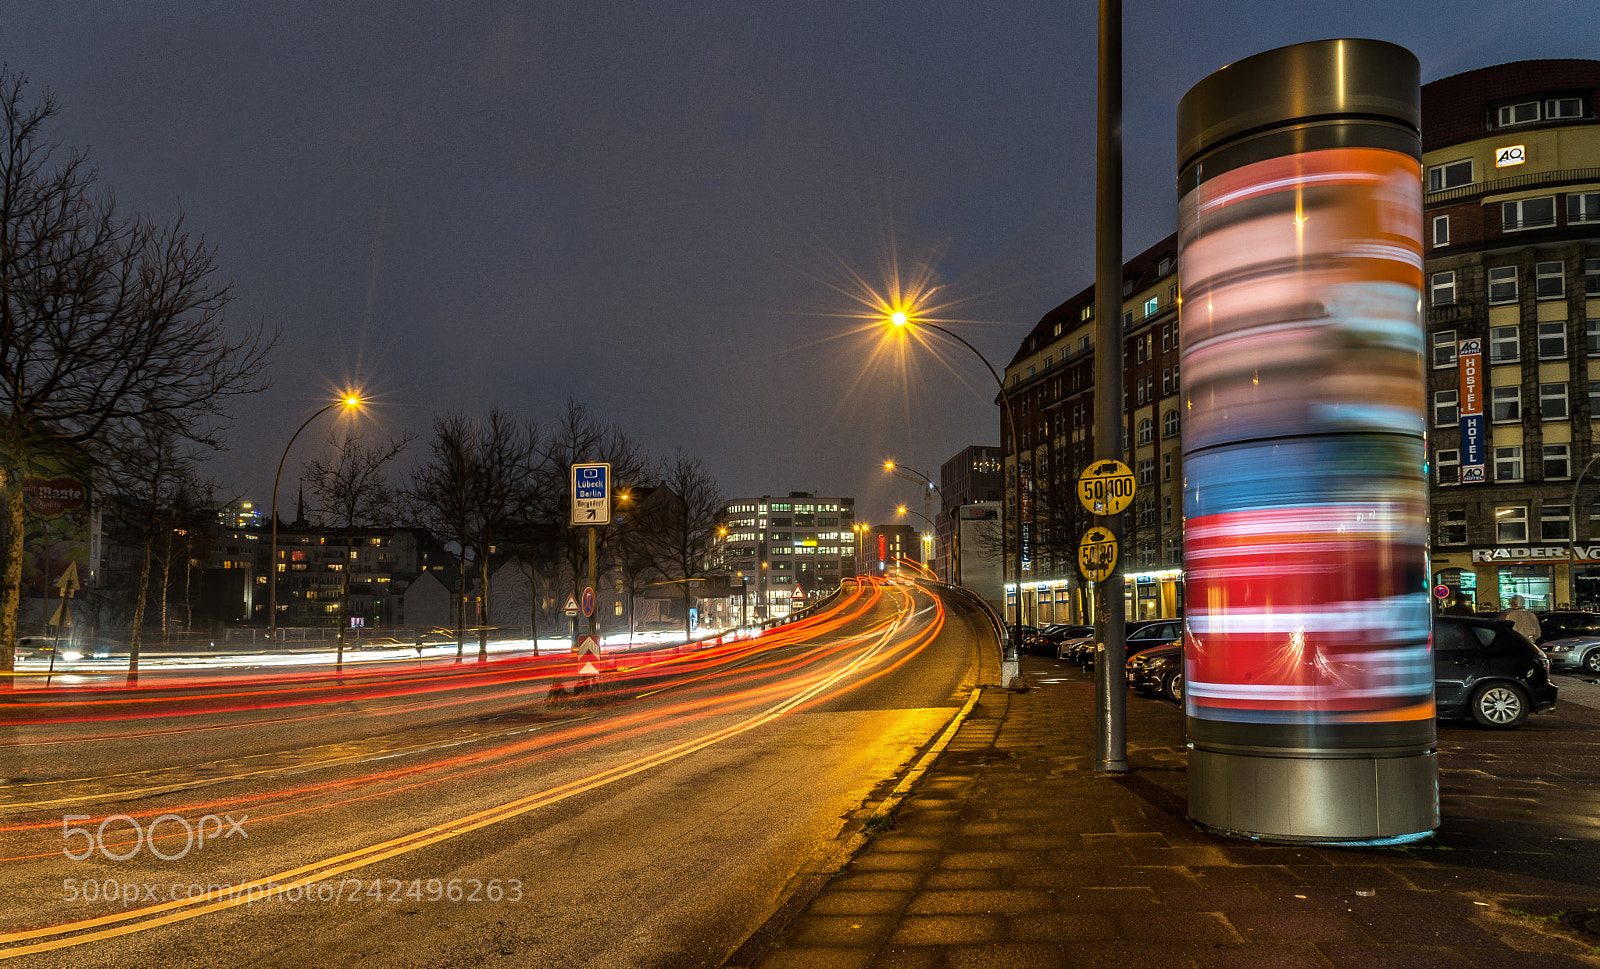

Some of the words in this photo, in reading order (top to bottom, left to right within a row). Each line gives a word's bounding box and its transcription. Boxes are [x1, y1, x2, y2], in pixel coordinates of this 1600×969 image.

[1465, 359, 1475, 411] HOSTEL
[1467, 419, 1477, 462] HOTEL
[39, 486, 82, 500] Monte
[577, 480, 604, 489] Lübeck
[579, 489, 602, 498] Berlin
[1084, 480, 1103, 500] 50
[1107, 478, 1132, 497] 100
